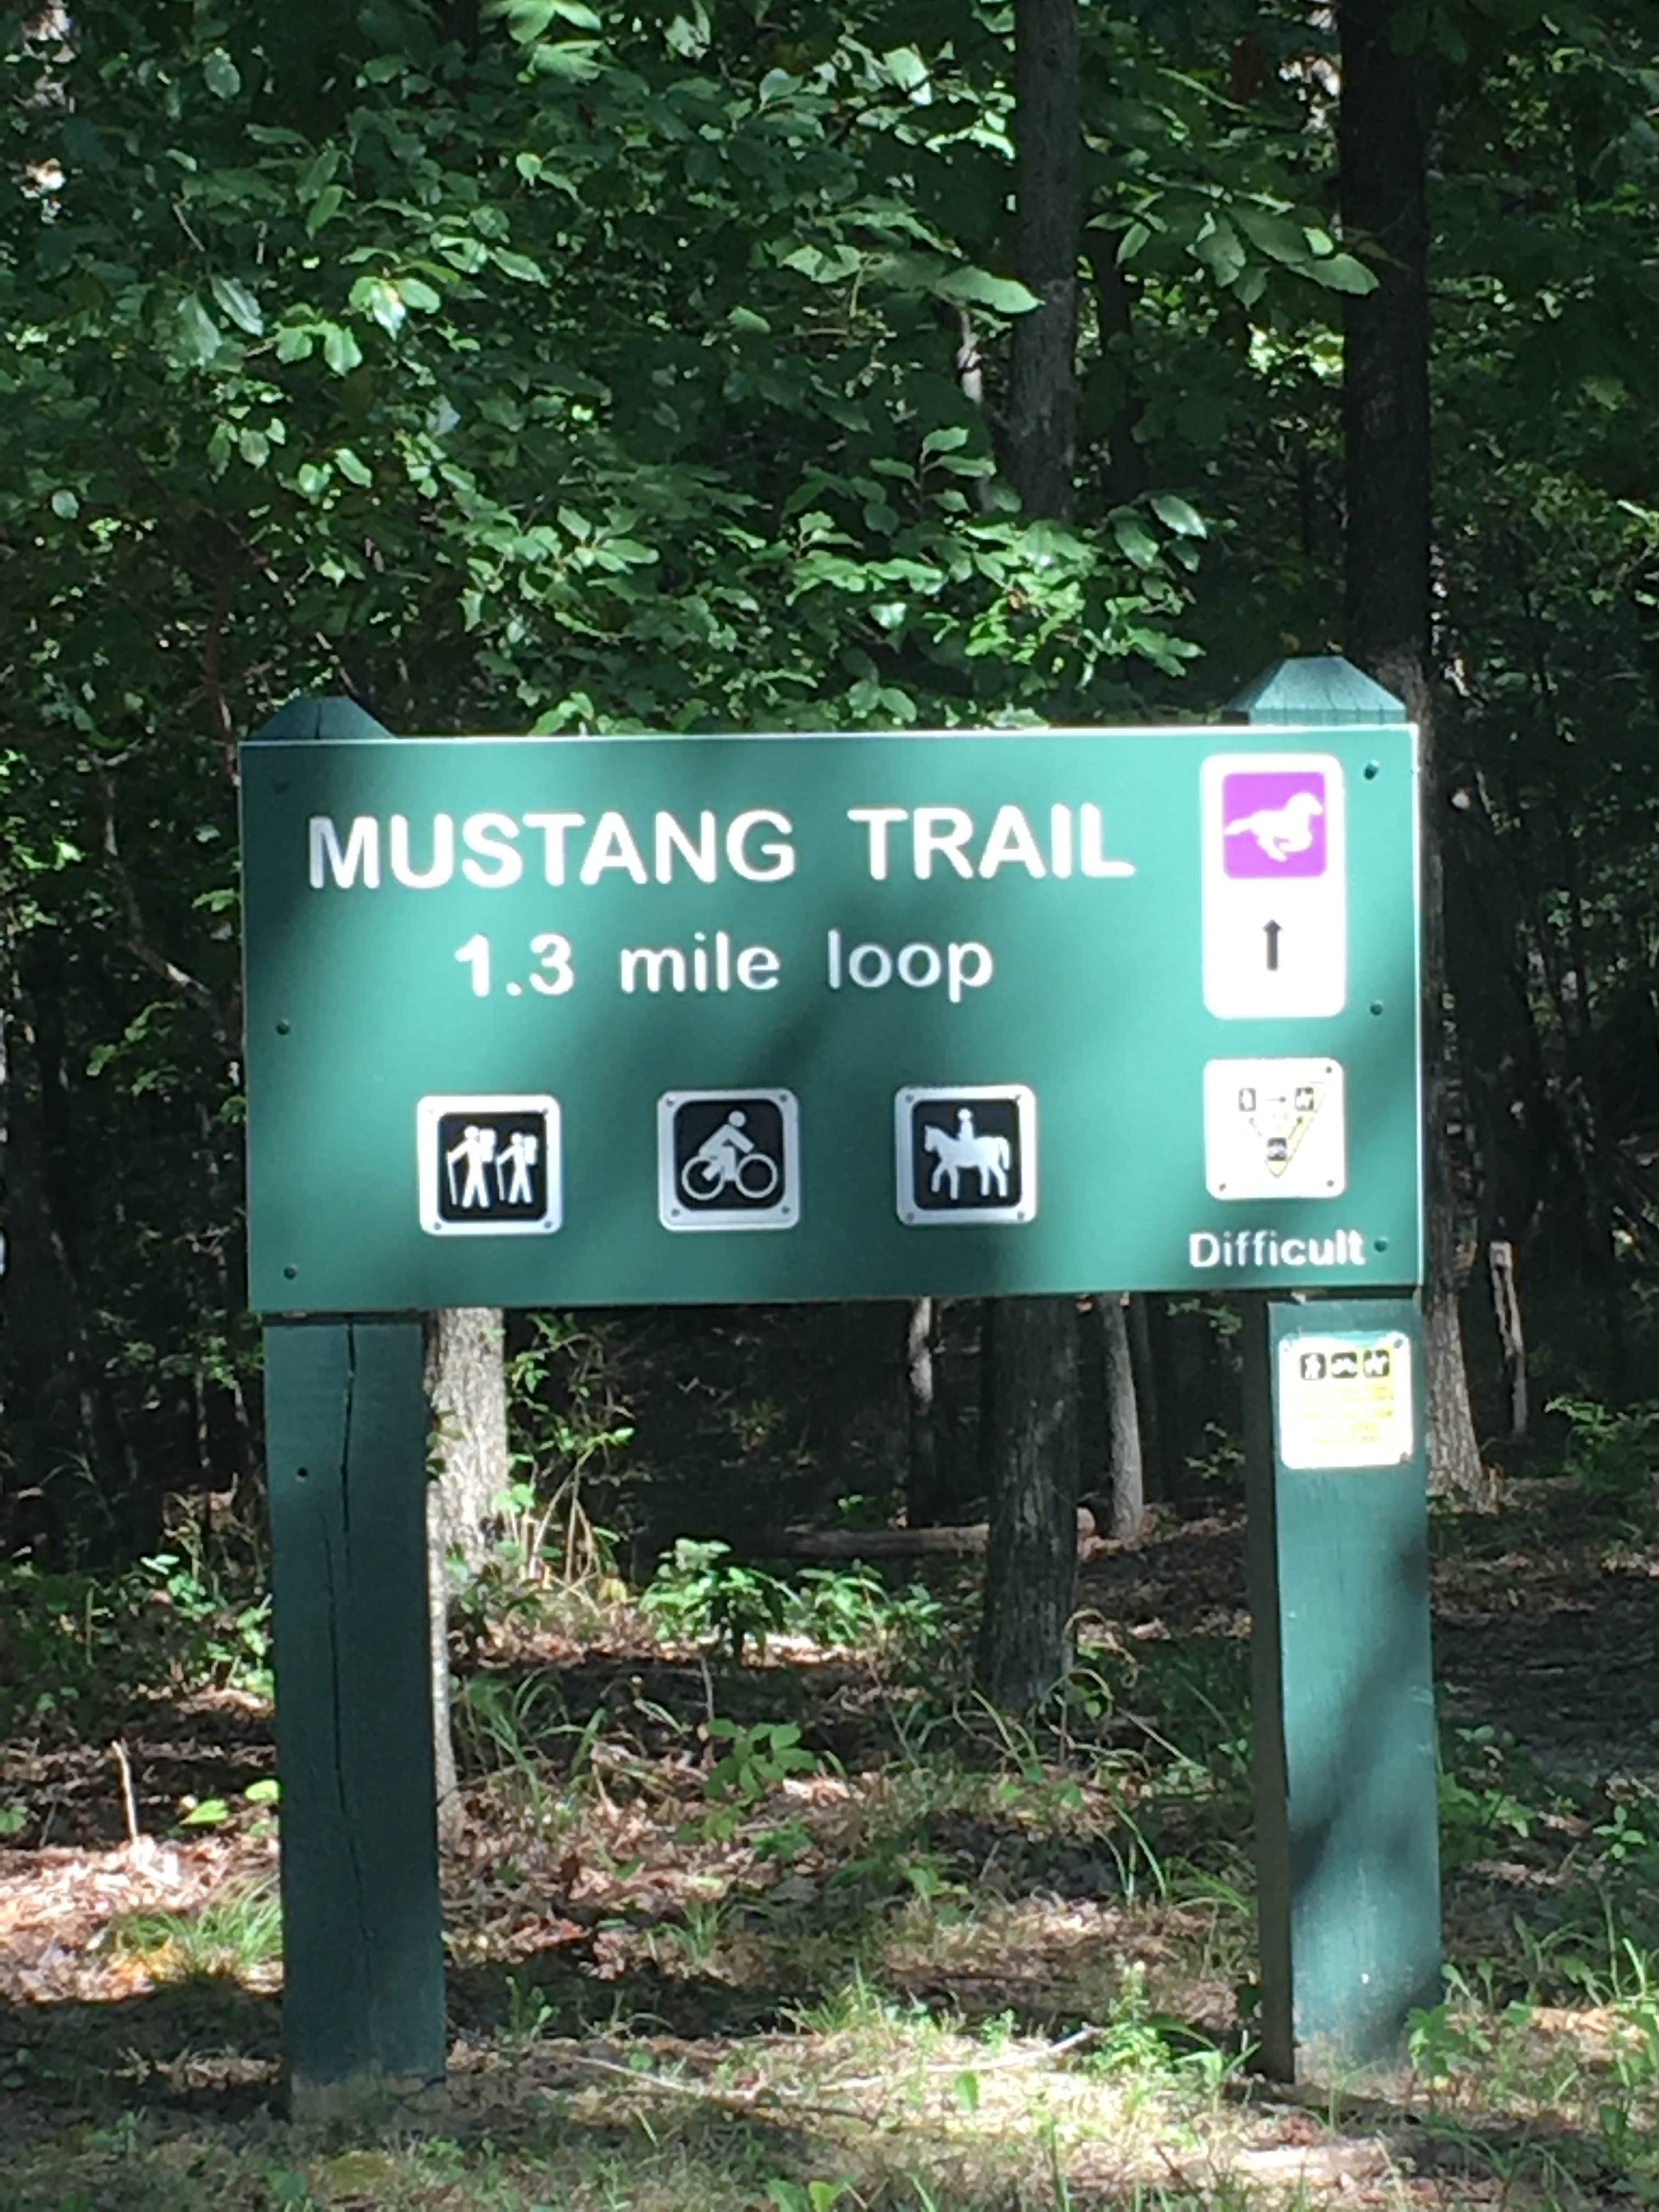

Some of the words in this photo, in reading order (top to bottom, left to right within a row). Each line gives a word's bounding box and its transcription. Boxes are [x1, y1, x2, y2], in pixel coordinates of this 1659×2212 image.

[310, 808, 795, 890] MUSTANG
[847, 798, 1137, 881] TRAIL
[453, 930, 575, 998] 1.3
[620, 930, 780, 994] mile
[827, 929, 994, 1003] loop
[1188, 1229, 1367, 1268] Difficult
